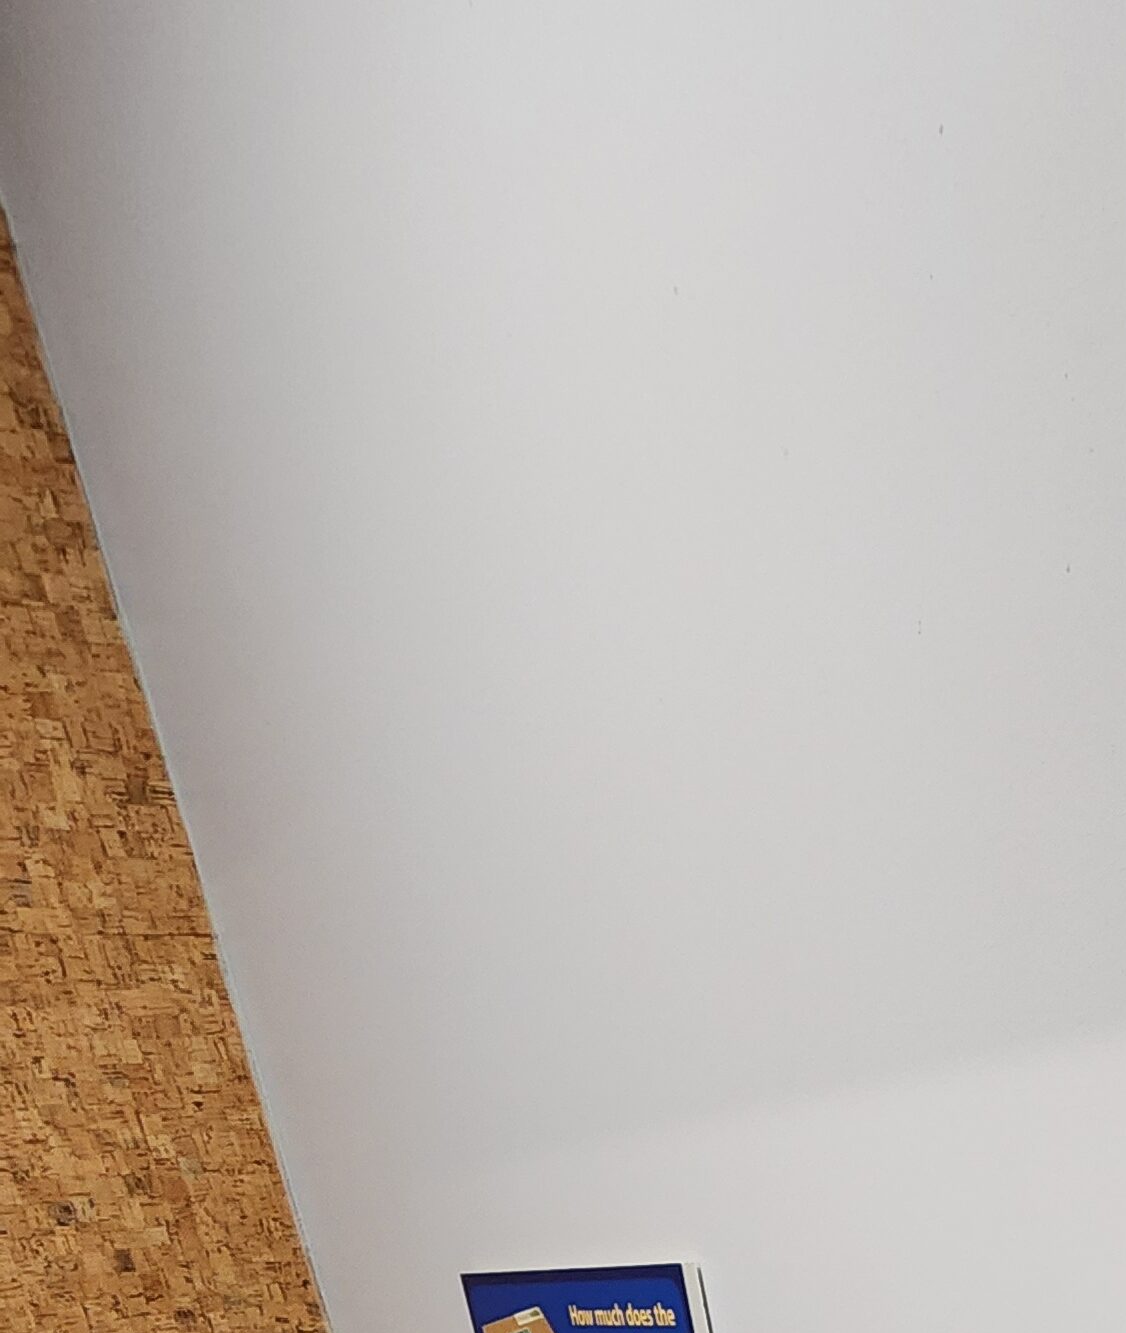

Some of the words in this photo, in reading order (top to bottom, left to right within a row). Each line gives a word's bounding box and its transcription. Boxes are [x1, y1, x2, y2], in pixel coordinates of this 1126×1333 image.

[568, 1304, 593, 1326] How
[594, 1302, 625, 1326] much
[625, 1302, 653, 1326] does
[653, 1301, 676, 1326] the
